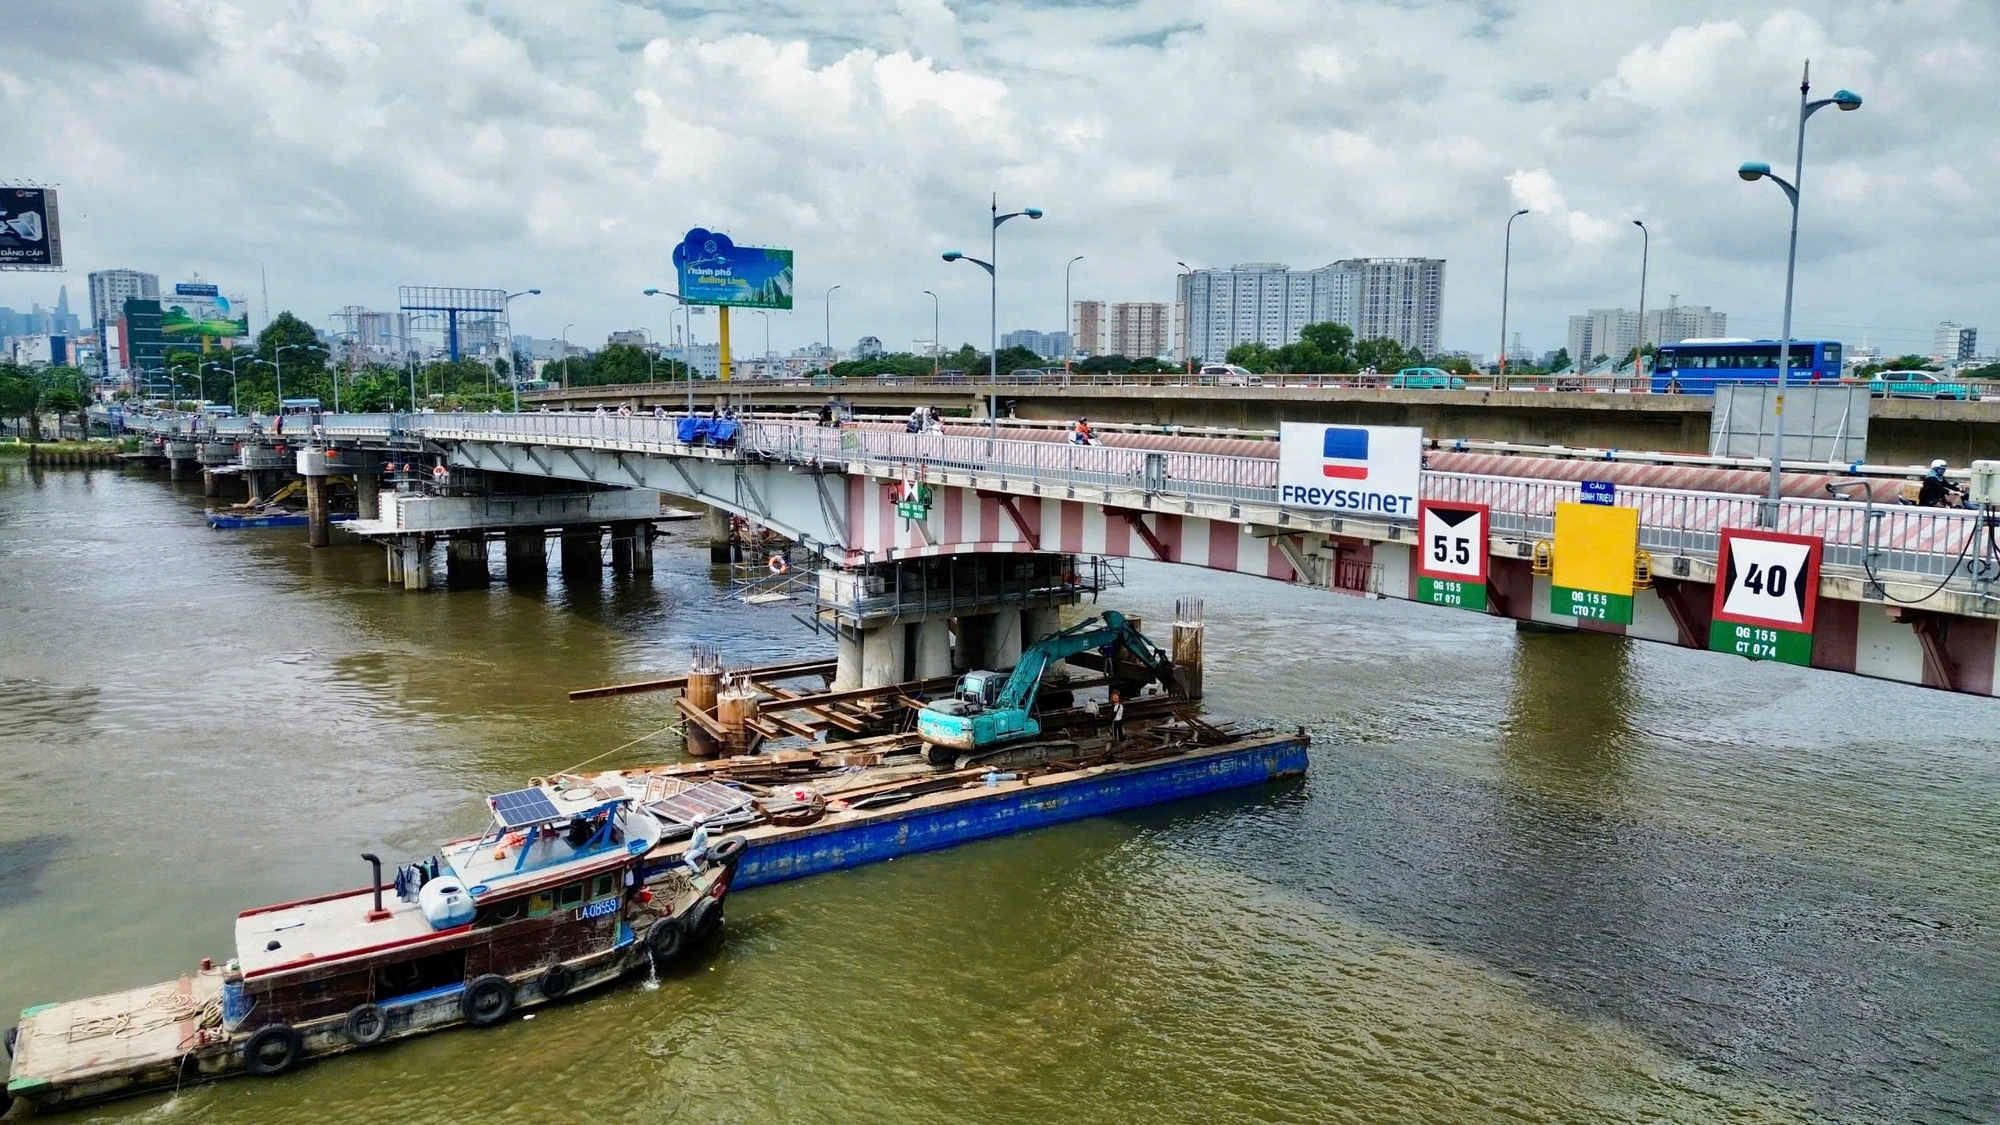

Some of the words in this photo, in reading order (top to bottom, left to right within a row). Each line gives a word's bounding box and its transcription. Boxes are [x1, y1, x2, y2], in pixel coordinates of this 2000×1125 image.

[714, 267, 732, 277] phố
[1596, 493, 1614, 504] TRIỆU
[1434, 535, 1470, 565] 5.5
[1433, 580, 1444, 590] QG
[1446, 582, 1462, 592] 155
[1744, 563, 1787, 597] 40
[1433, 592, 1444, 602] CT
[1445, 594, 1461, 605] 070
[1571, 591, 1584, 602] QG
[1735, 626, 1751, 639] QG
[1754, 629, 1777, 642] 155
[1735, 641, 1750, 653] CT
[1753, 644, 1776, 657] 074
